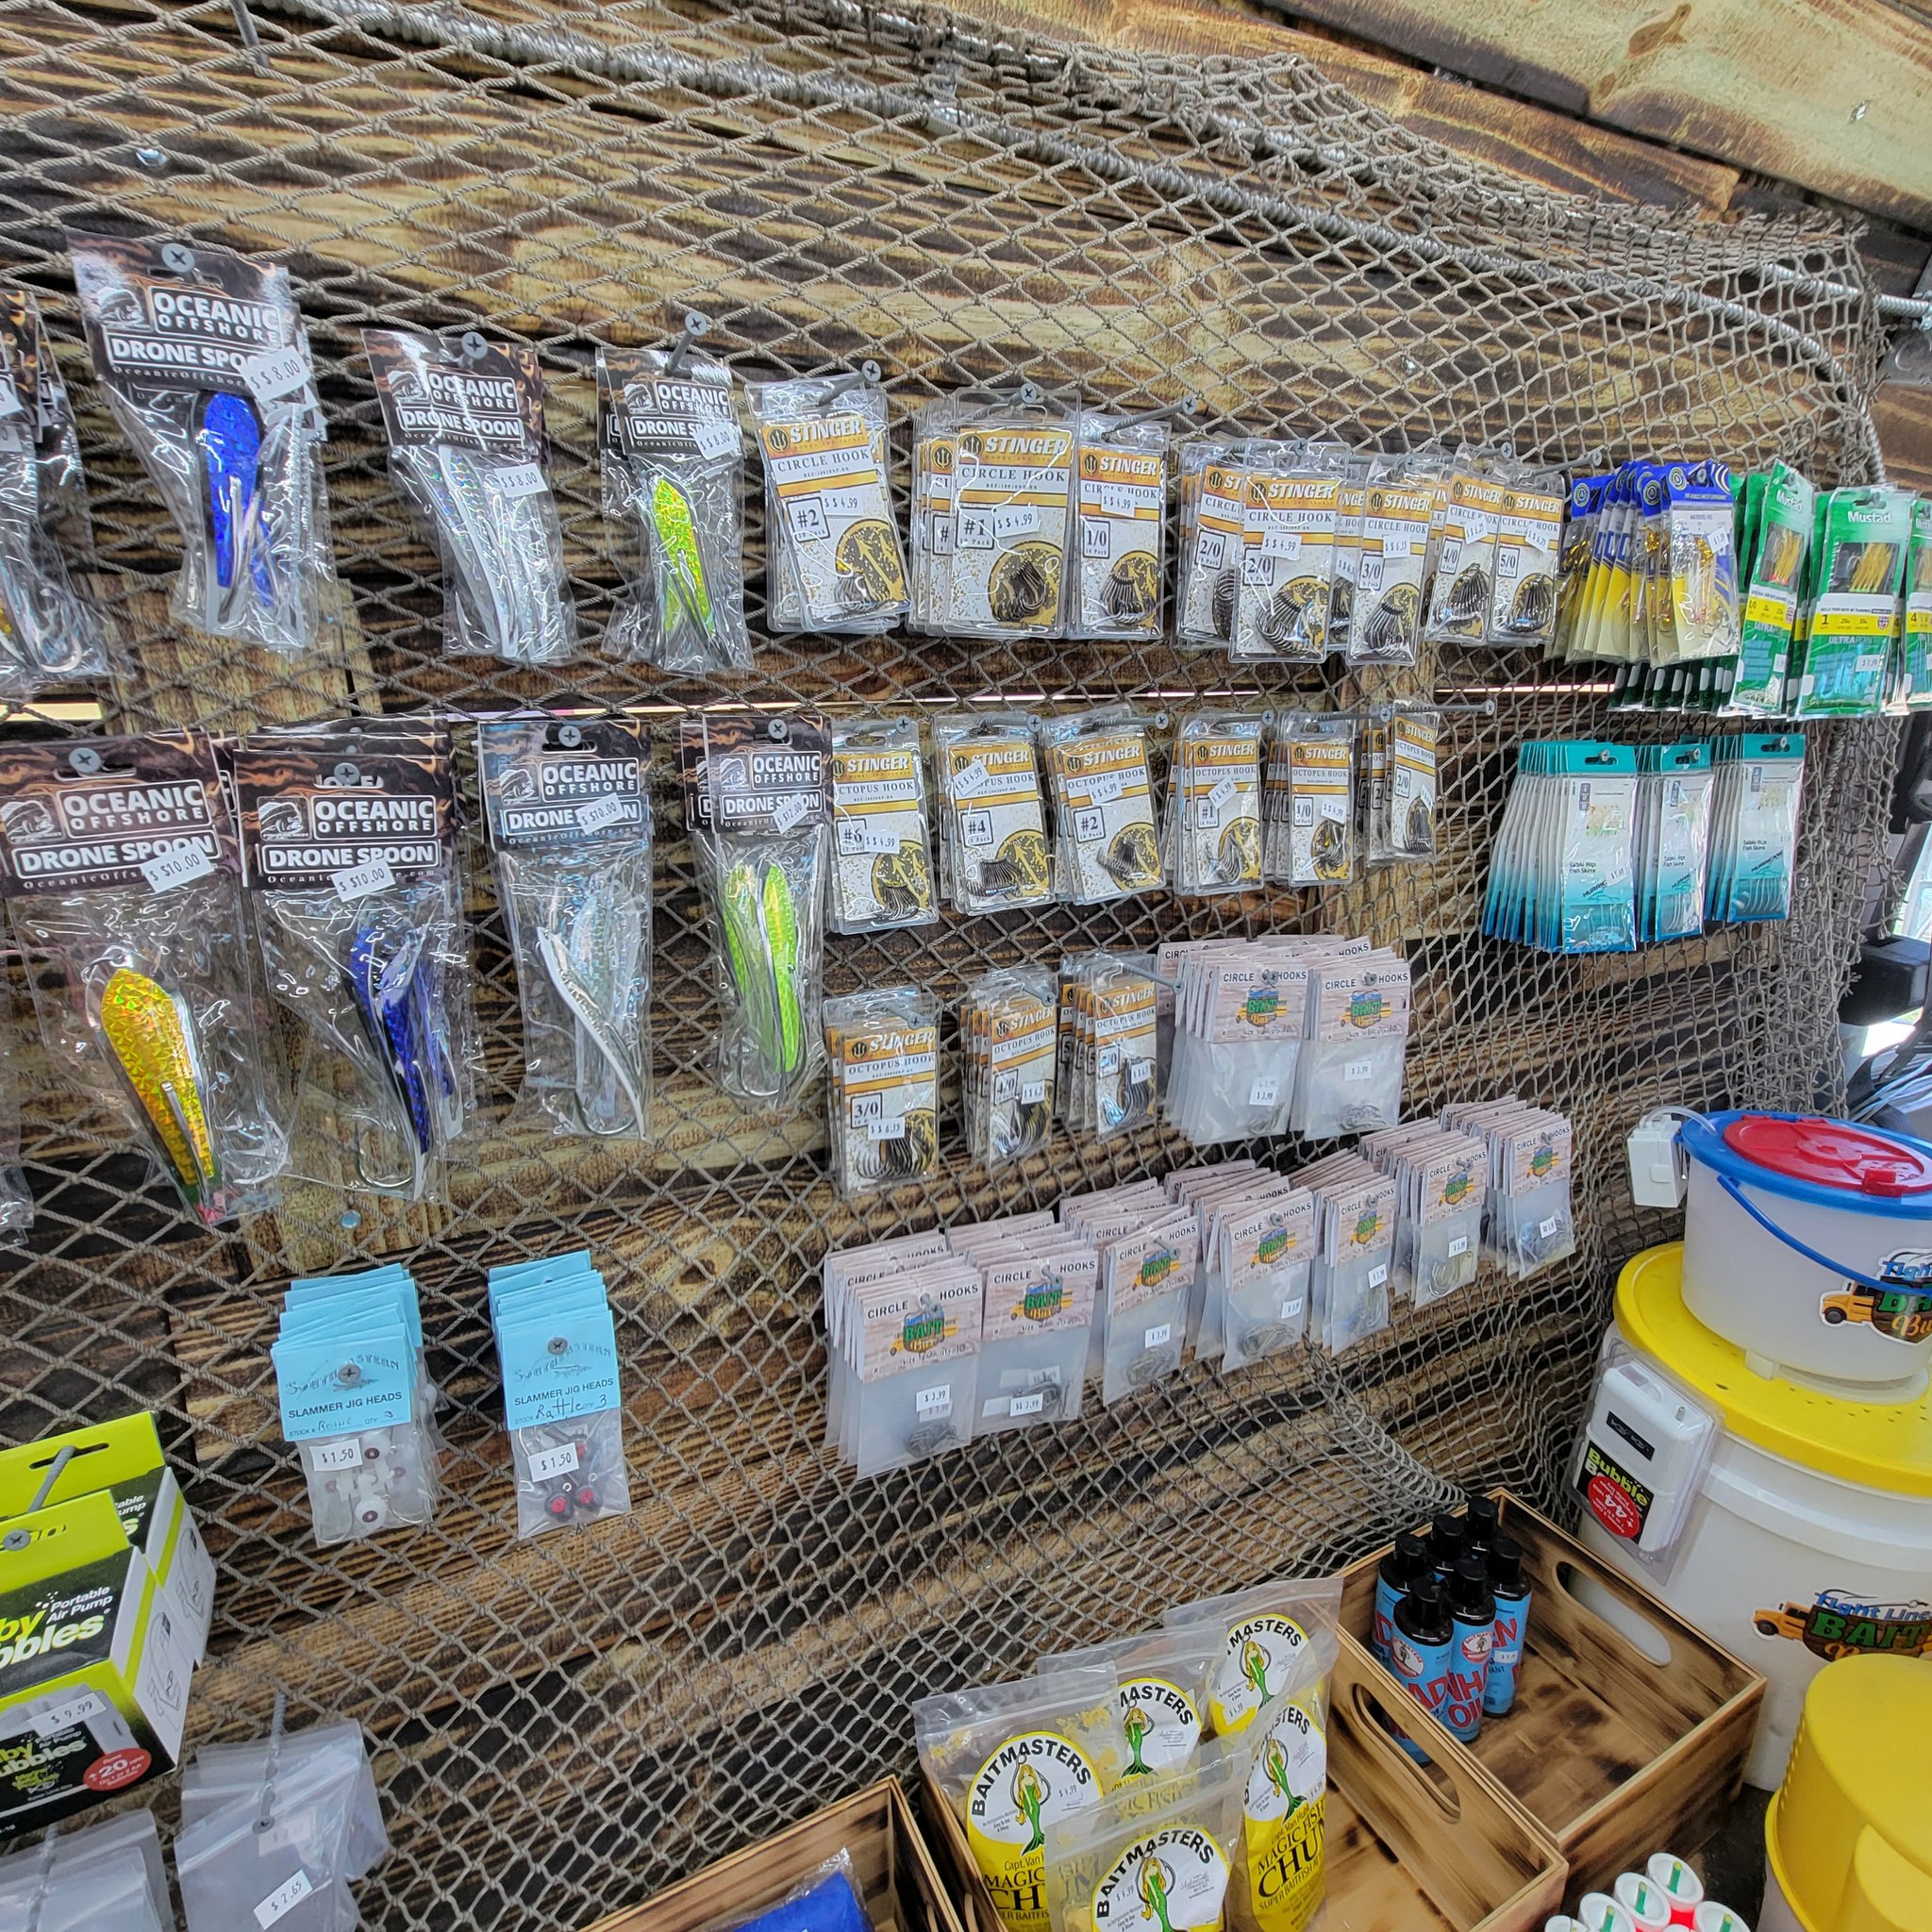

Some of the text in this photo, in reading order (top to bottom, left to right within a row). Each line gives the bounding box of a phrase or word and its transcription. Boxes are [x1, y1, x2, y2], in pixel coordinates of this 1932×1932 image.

[153, 291, 280, 331] OCEANIC
[158, 314, 277, 342] OFFSHORE
[113, 338, 259, 370] DRONE SPO
[428, 373, 515, 398] OCEANIC
[434, 391, 515, 409] OFFSHORE
[658, 384, 728, 406] OCEANIC
[401, 410, 521, 436] DRONE SPOON
[634, 420, 687, 436] DRONE
[790, 419, 862, 443] STINGER
[986, 437, 1067, 455] STINGER
[777, 455, 827, 473] CIRCLE
[833, 448, 870, 464] HOOK
[1100, 456, 1157, 476] STINGER
[961, 466, 1066, 482] CIRCLE HOOK
[1127, 488, 1158, 499] HOOK
[1268, 483, 1334, 500] STINGER
[1462, 484, 1502, 505] STINGER
[1383, 494, 1430, 512] STINGER
[1516, 498, 1560, 514] STINGER
[1775, 489, 1804, 513] Mustad
[797, 508, 820, 527] #2
[1248, 512, 1333, 523] CIRCLE HOOK
[1450, 508, 1476, 520] CIRCLE
[1847, 510, 1891, 524] Mustad
[964, 518, 986, 536] #1
[1368, 520, 1427, 534] CIRCLE HOOK
[1536, 523, 1558, 533] HOOK
[1087, 530, 1108, 545] 1/0
[1199, 540, 1221, 558] 2/0
[1443, 550, 1458, 564] 4/0
[1247, 558, 1271, 575] 2/0
[1500, 555, 1516, 568] 5/0
[1361, 567, 1381, 579] 3/0
[1821, 614, 1829, 625] 1
[1405, 724, 1435, 744] STINGER
[1084, 745, 1141, 766] STINGER
[1209, 744, 1254, 756] STINGER
[1305, 748, 1347, 760] STINGER
[1395, 741, 1419, 755] OCTOPUS
[542, 762, 637, 784] OCEANIC
[754, 756, 820, 773] OCEANIC
[846, 757, 909, 773] STINGER
[1195, 766, 1257, 776] OCTOPUS HOOK
[755, 773, 819, 784] OFFSHORE
[1004, 771, 1035, 785] HOOK
[1118, 769, 1145, 780] HOOK
[1292, 770, 1348, 778] OCTOPUS HOOK
[1396, 774, 1409, 787] 2/0
[544, 780, 635, 795] OFFSHORE
[883, 781, 914, 792] HOOK
[63, 785, 205, 818] OCEANIC
[314, 801, 434, 820] OCEANIC
[725, 797, 774, 814] DRONE
[70, 807, 204, 830] OFFSHORE
[508, 809, 575, 830] DRONE
[1201, 806, 1215, 819] #1
[1296, 805, 1311, 817] 1/0
[317, 820, 432, 832] OFFSHORE
[968, 819, 987, 834] #4
[1080, 816, 1099, 831] #2
[843, 826, 863, 843] #6
[21, 844, 118, 873] DRONE
[268, 845, 433, 867] DRONE SPOON
[1223, 971, 1307, 982] CIRCLE HOOKS
[1324, 973, 1408, 991] CIRCLE HOOKS
[1112, 989, 1155, 1007] STINGER
[1010, 1007, 1055, 1030] STINGER
[1137, 1008, 1156, 1021] HOOK
[870, 1031, 935, 1053] STINGER
[993, 1027, 1056, 1055] OCTOPUS HOOK
[848, 1058, 900, 1074] OCTOPUS
[854, 1102, 879, 1119] 3/0
[1516, 1138, 1537, 1151] CIRCLE
[1429, 1163, 1451, 1178] CIRCLE
[1341, 1200, 1361, 1216] CIRCLE
[1234, 1202, 1312, 1241] CIRCLE HOOKS
[1096, 1225, 1128, 1239] CIRCLE
[1119, 1224, 1196, 1261] CIRCLE HOOKS
[993, 1260, 1095, 1285] CIRCLE HOOKS
[867, 1283, 979, 1319] CIRCLE HOOKS
[904, 1321, 942, 1341] BAIT
[514, 1378, 614, 1407] SLAMMER JIG HEADS
[596, 1393, 608, 1410] 3
[288, 1391, 402, 1419] SLAMMER JIG HEADS
[536, 1397, 584, 1420] Rattle
[322, 1448, 355, 1463] $1.50
[541, 1452, 572, 1471] $1.50
[1588, 1446, 1648, 1507] Bubble
[50, 1586, 111, 1612] Portable
[1814, 1591, 1881, 1619] Tight
[46, 1594, 113, 1624] Air Pump
[1810, 1610, 1931, 1649] BAIT
[98, 1758, 128, 1776] 20
[972, 1739, 1091, 1817] BAITMASTERS
[1257, 1833, 1300, 1875] MAGIC
[1004, 1856, 1041, 1872] Capt. Van
[984, 1866, 1045, 1888] MAGIC
[1096, 1829, 1214, 1919] BAITMASTERS
[272, 1879, 303, 1911] $2.65
[1258, 1866, 1313, 1911] SUPER BAITFISH
